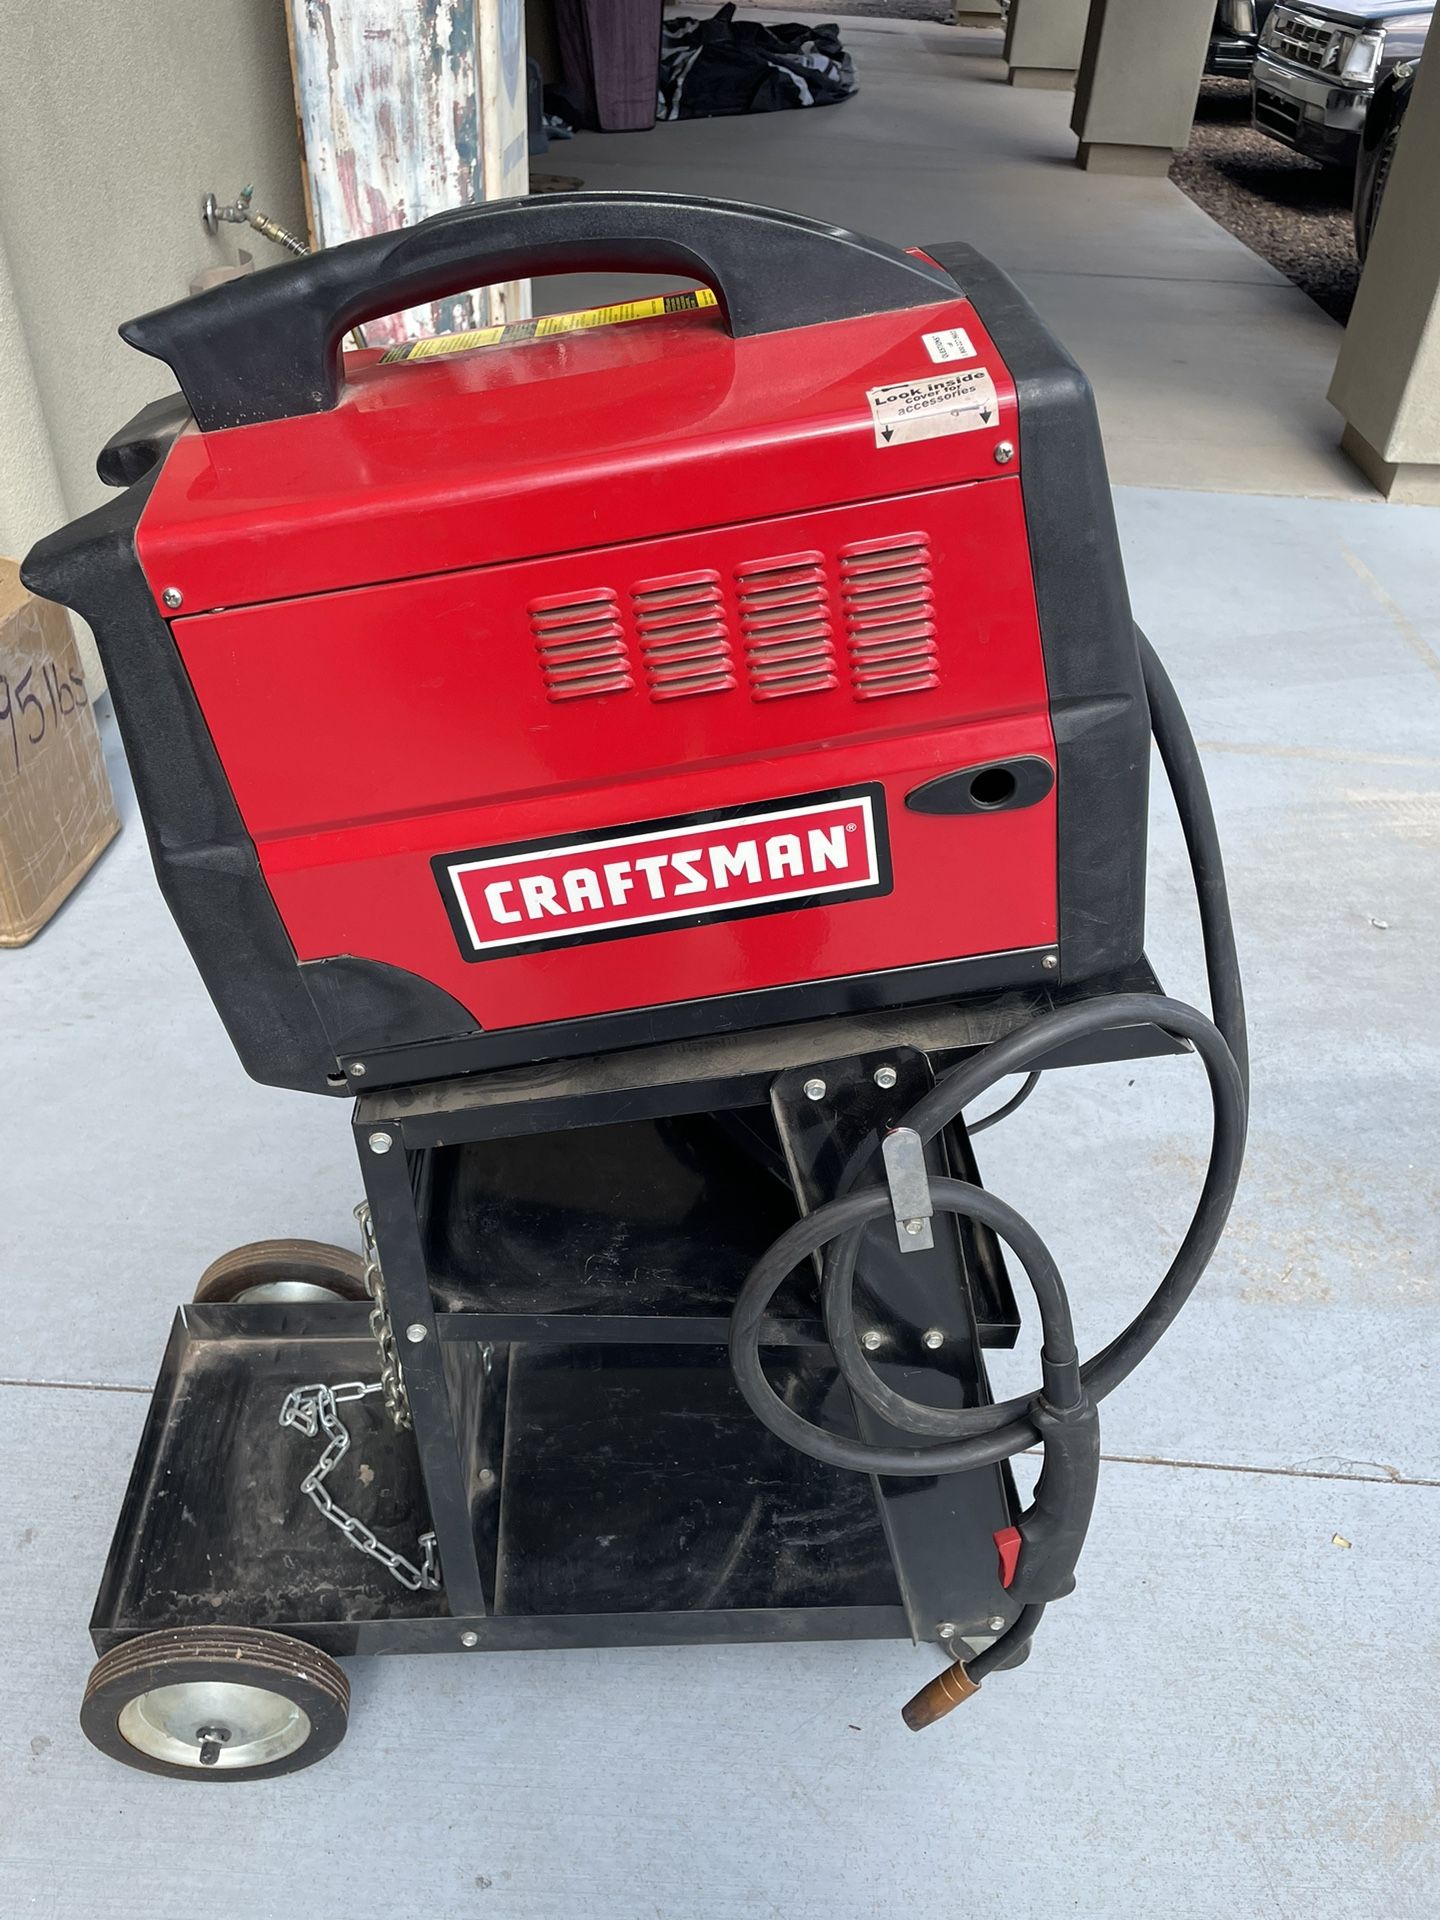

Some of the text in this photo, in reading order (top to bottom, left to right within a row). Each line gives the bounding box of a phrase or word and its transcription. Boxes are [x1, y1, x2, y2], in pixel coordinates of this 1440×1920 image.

[875, 372, 985, 405] Look inside
[898, 387, 976, 415] accessories
[905, 384, 961, 404] cover for
